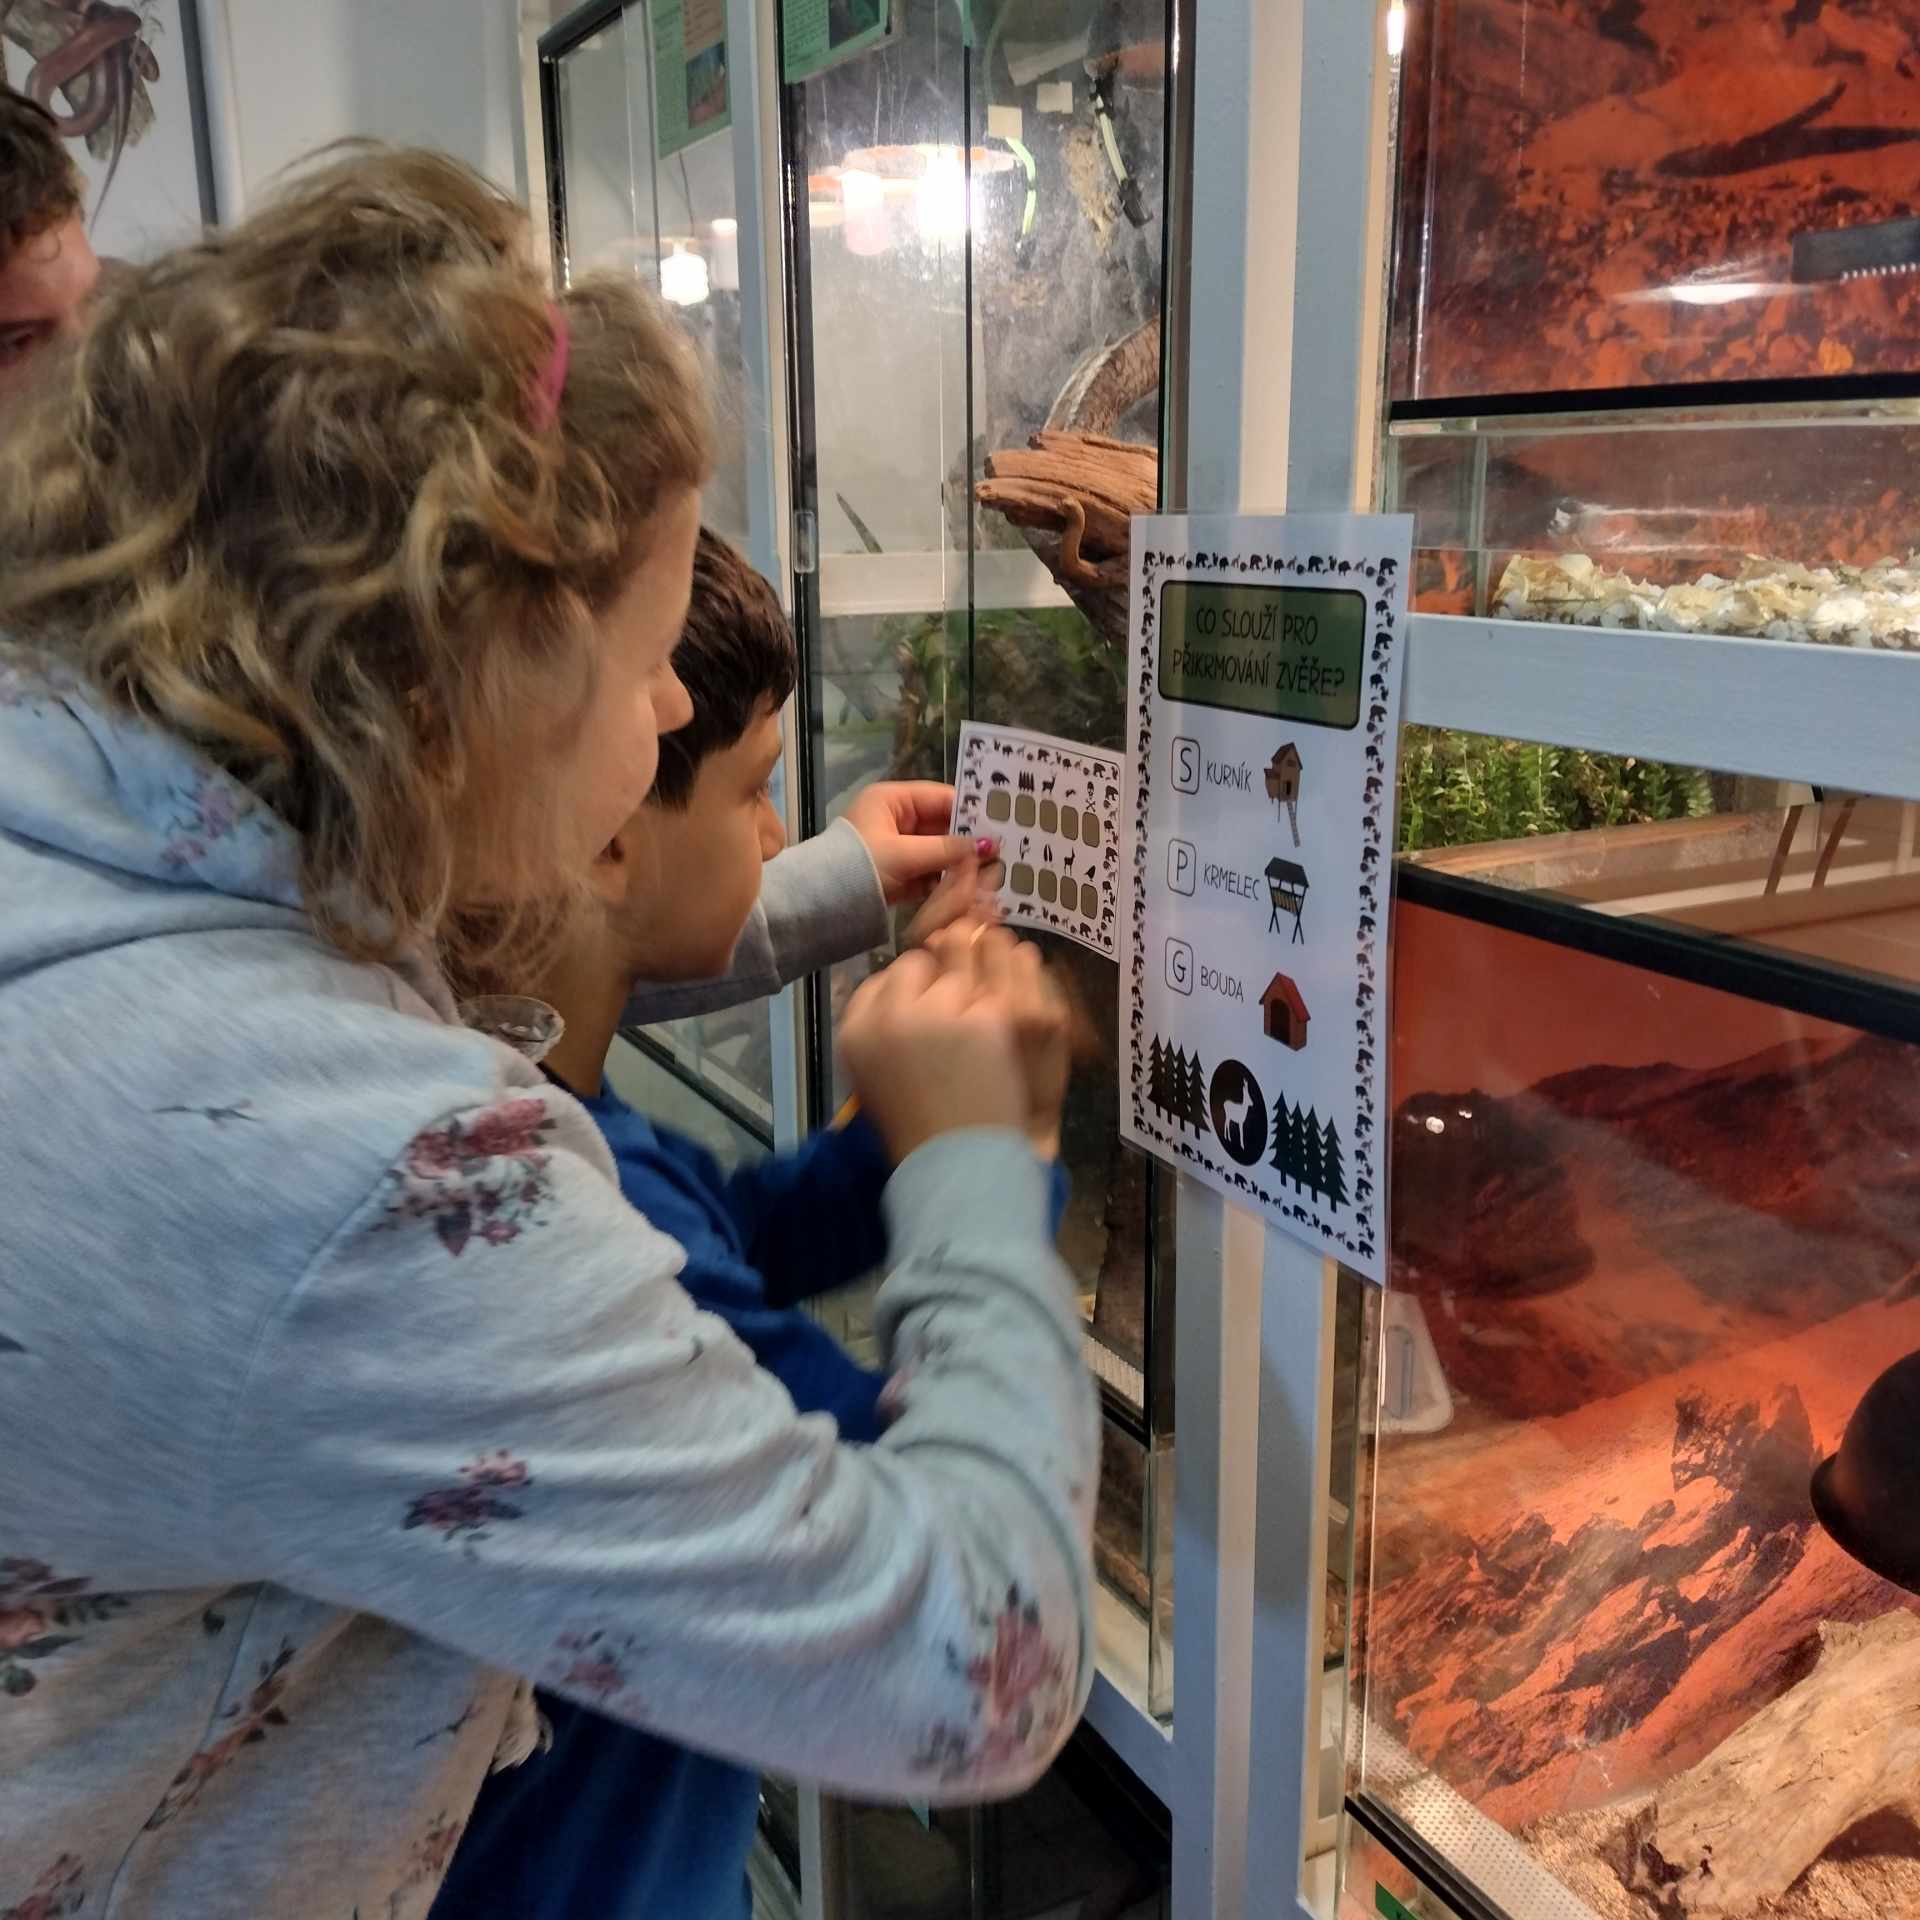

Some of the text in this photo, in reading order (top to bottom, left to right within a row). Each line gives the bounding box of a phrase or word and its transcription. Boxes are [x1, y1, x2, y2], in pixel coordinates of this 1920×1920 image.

[1196, 604, 1318, 646] CO SLOUŽÍ PRO
[1173, 641, 1345, 697] PŘIKRMOVÁNÍ ZVĚŘE?
[1179, 747, 1252, 793] S KURNÍK
[1176, 848, 1260, 901] P KRMELEC
[1172, 950, 1244, 1002] G BOUDA
